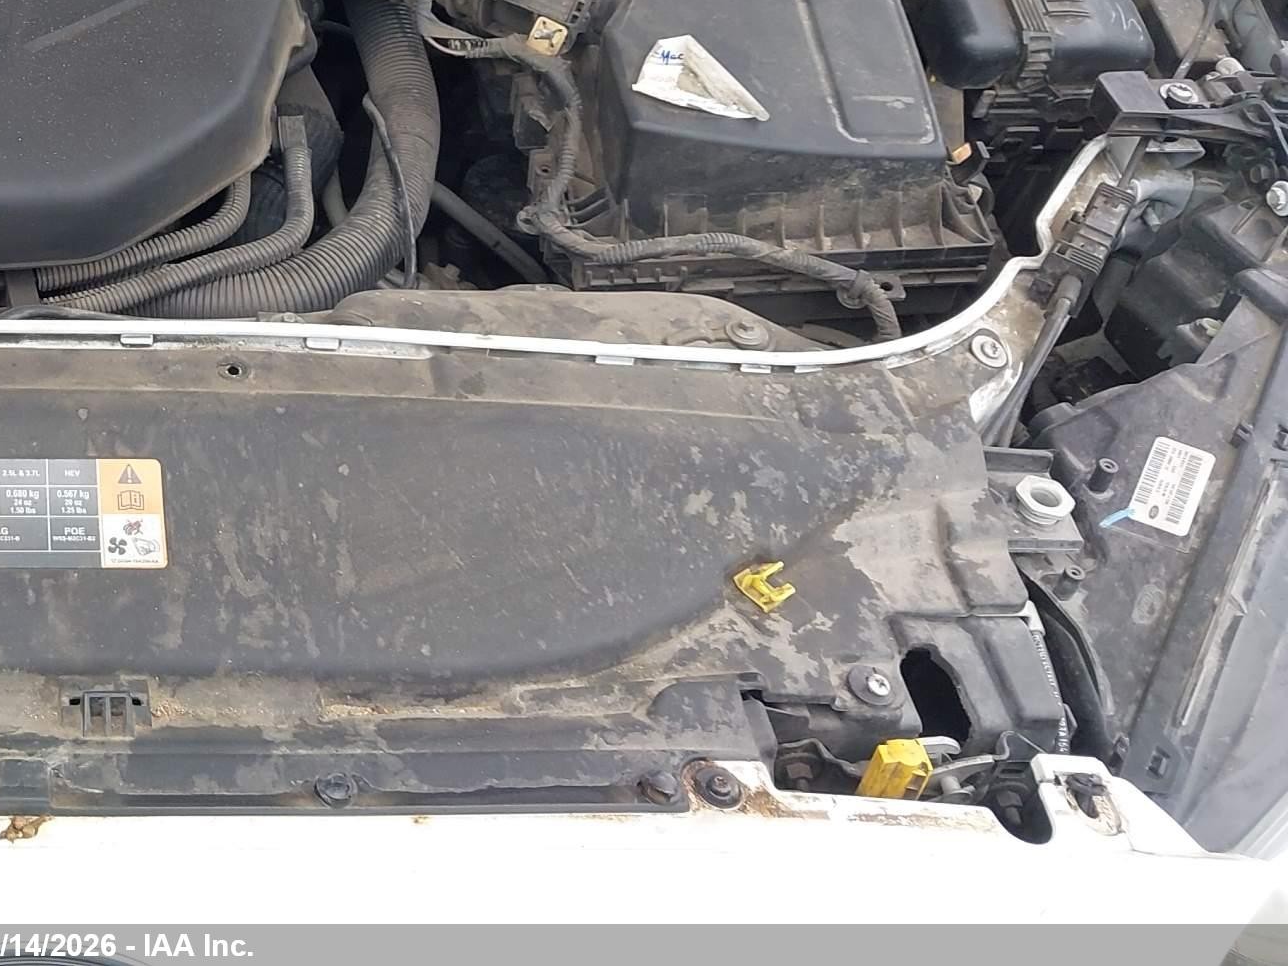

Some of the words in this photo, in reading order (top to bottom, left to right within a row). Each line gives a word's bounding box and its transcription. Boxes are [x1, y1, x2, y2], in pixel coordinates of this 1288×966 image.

[5, 490, 28, 498] 0.680
[29, 490, 40, 500] kg
[56, 490, 78, 498] 0.567
[79, 490, 90, 500] kg
[64, 527, 85, 535] POE
